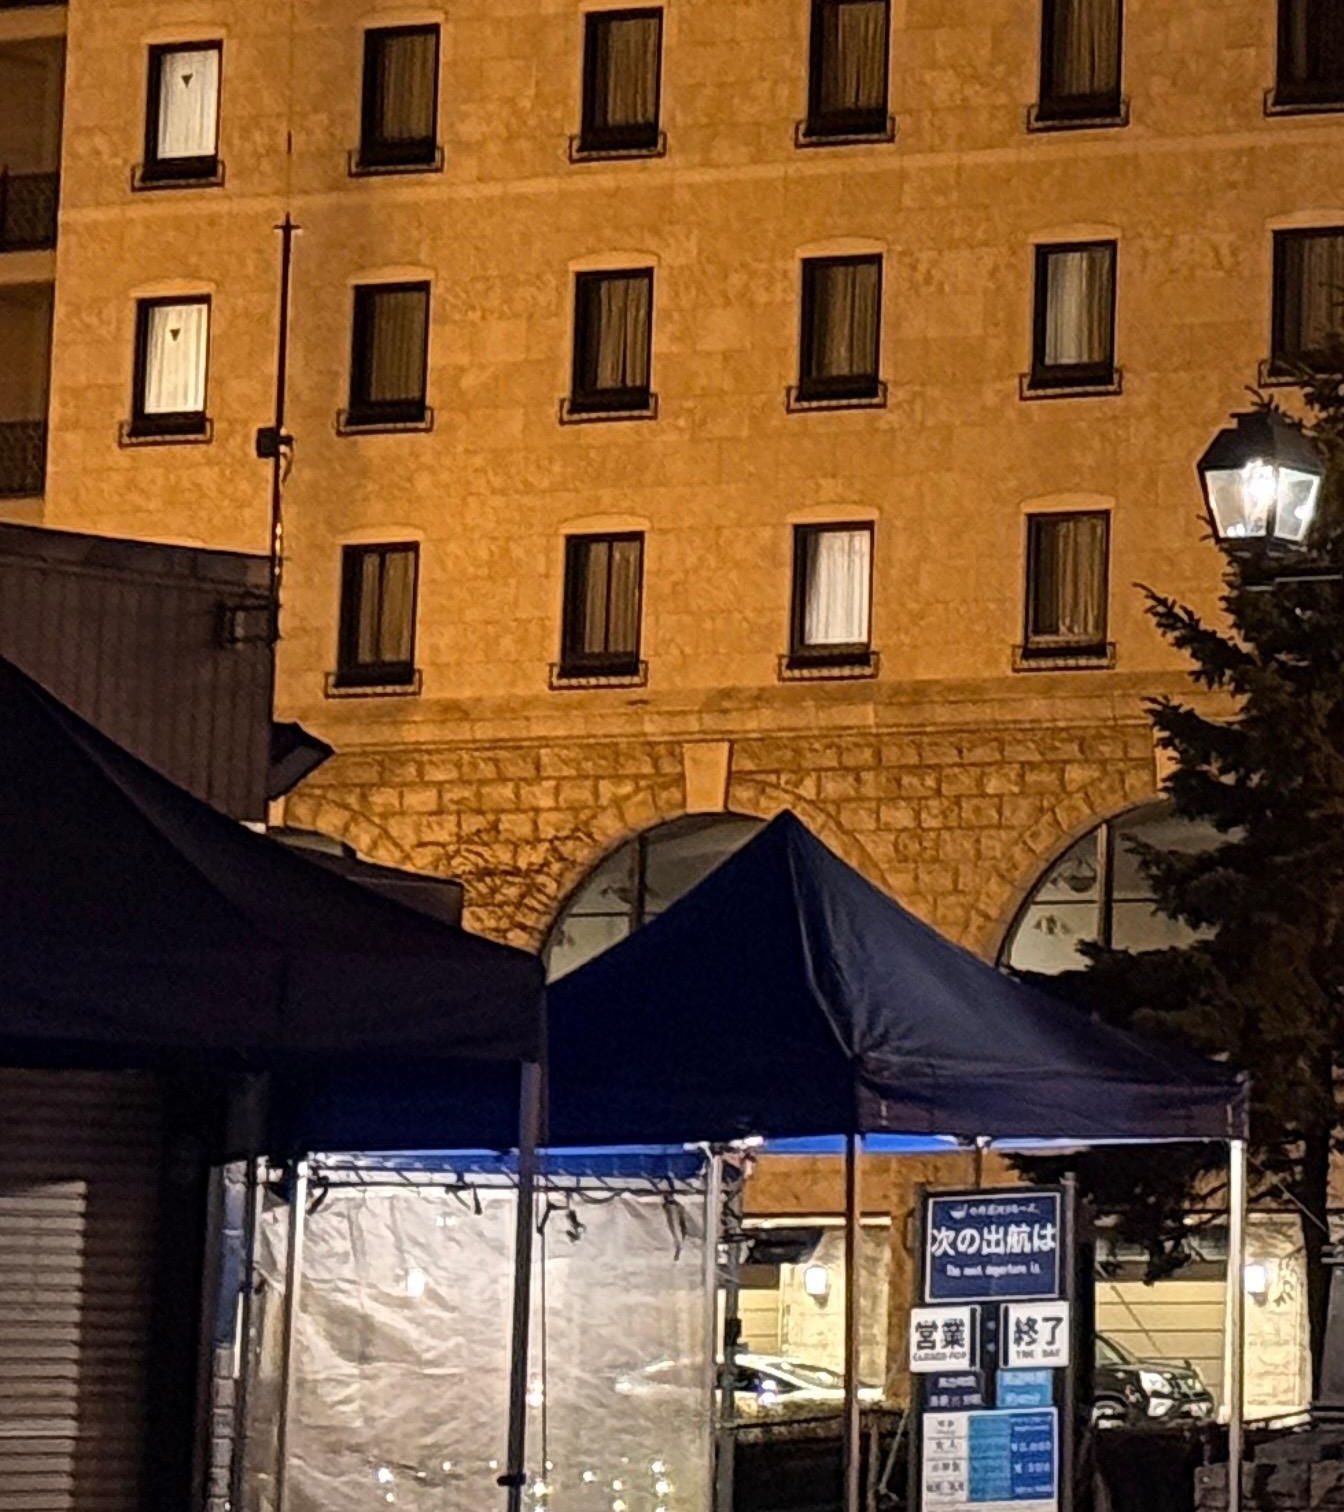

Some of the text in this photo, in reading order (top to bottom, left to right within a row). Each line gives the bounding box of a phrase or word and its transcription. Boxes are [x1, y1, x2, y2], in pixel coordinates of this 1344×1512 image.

[931, 1222, 1056, 1257] 次の出航は
[915, 1318, 965, 1351] 営業
[1013, 1316, 1064, 1347] 終了
